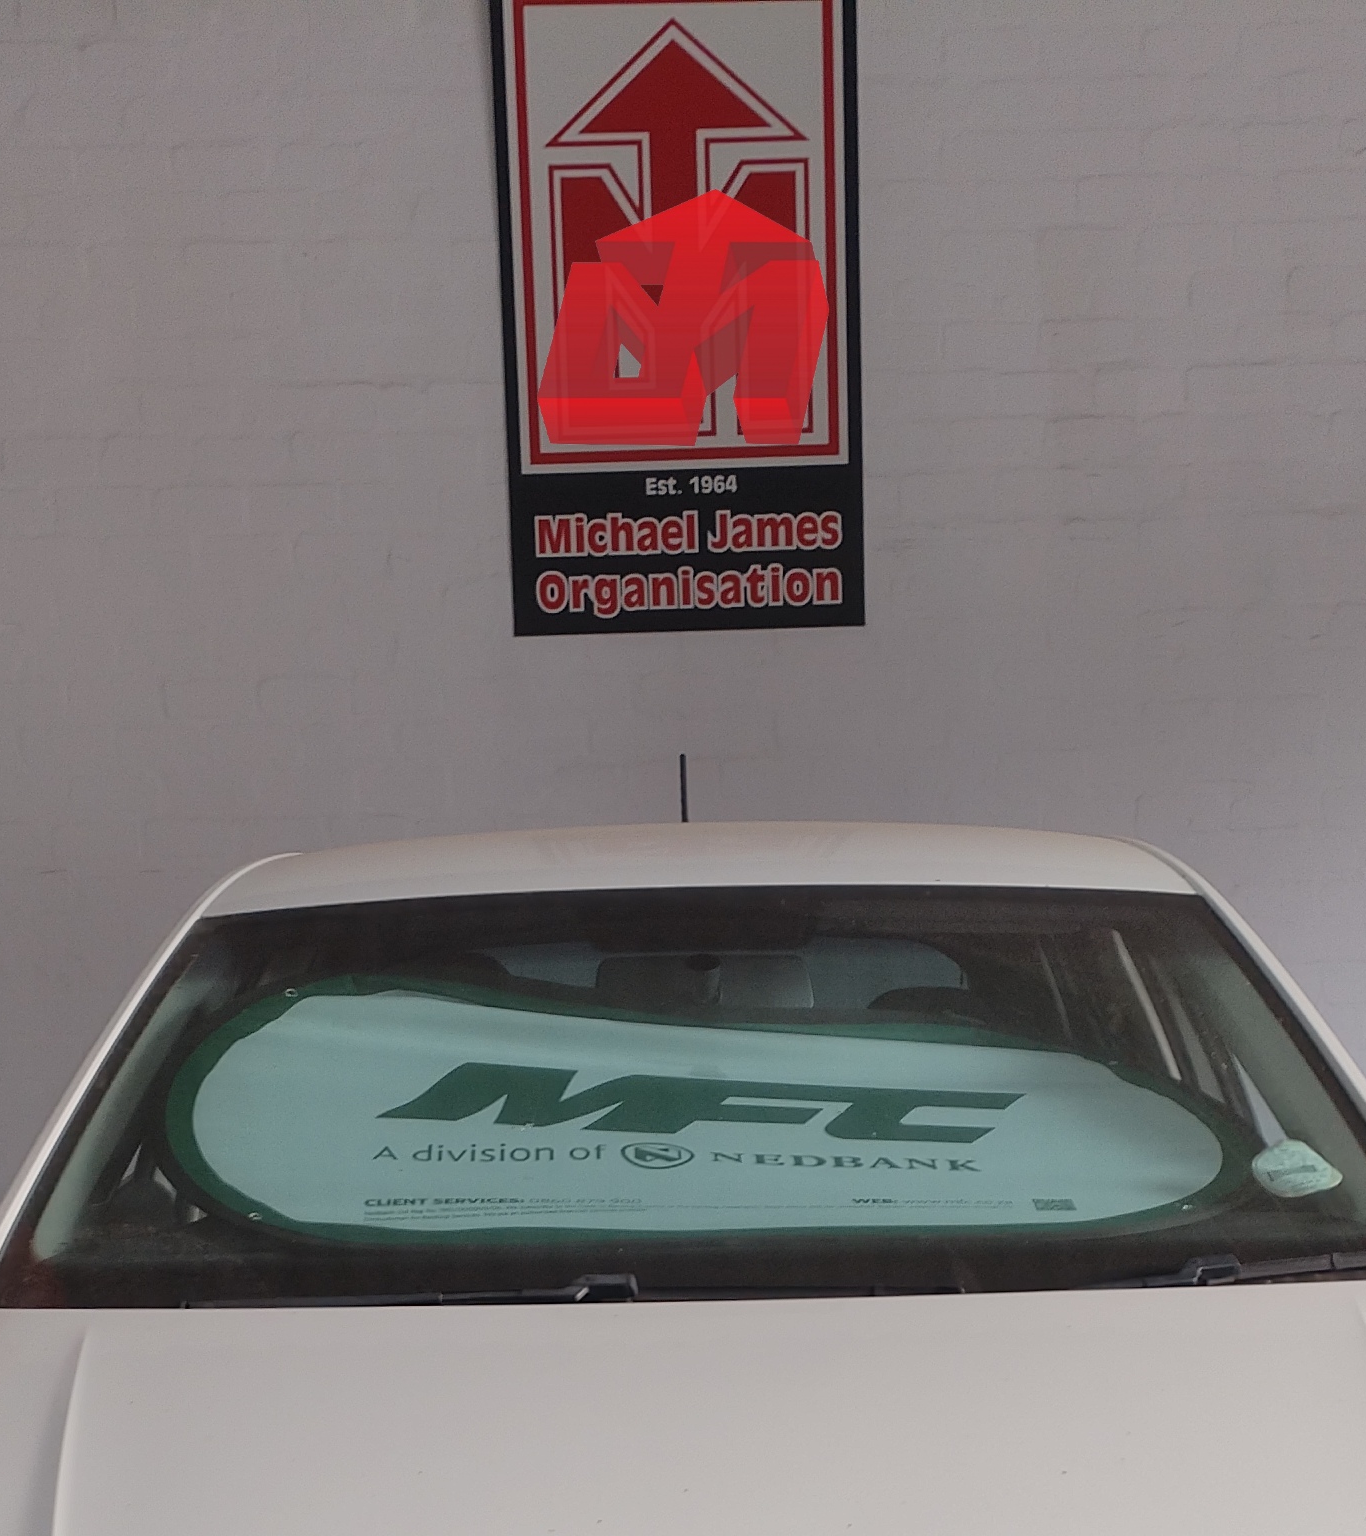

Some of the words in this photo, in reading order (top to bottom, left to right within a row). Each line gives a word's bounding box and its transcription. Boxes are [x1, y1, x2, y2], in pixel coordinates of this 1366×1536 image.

[645, 477, 683, 496] Est.
[689, 475, 738, 494] 1964
[535, 511, 699, 557] Michael
[708, 510, 843, 552] James
[537, 564, 843, 618] Organisation
[375, 1060, 1028, 1144] MFC
[373, 1144, 398, 1161] A
[412, 1142, 553, 1164] division
[568, 1143, 607, 1161] of
[710, 1150, 982, 1172] NEDBANK
